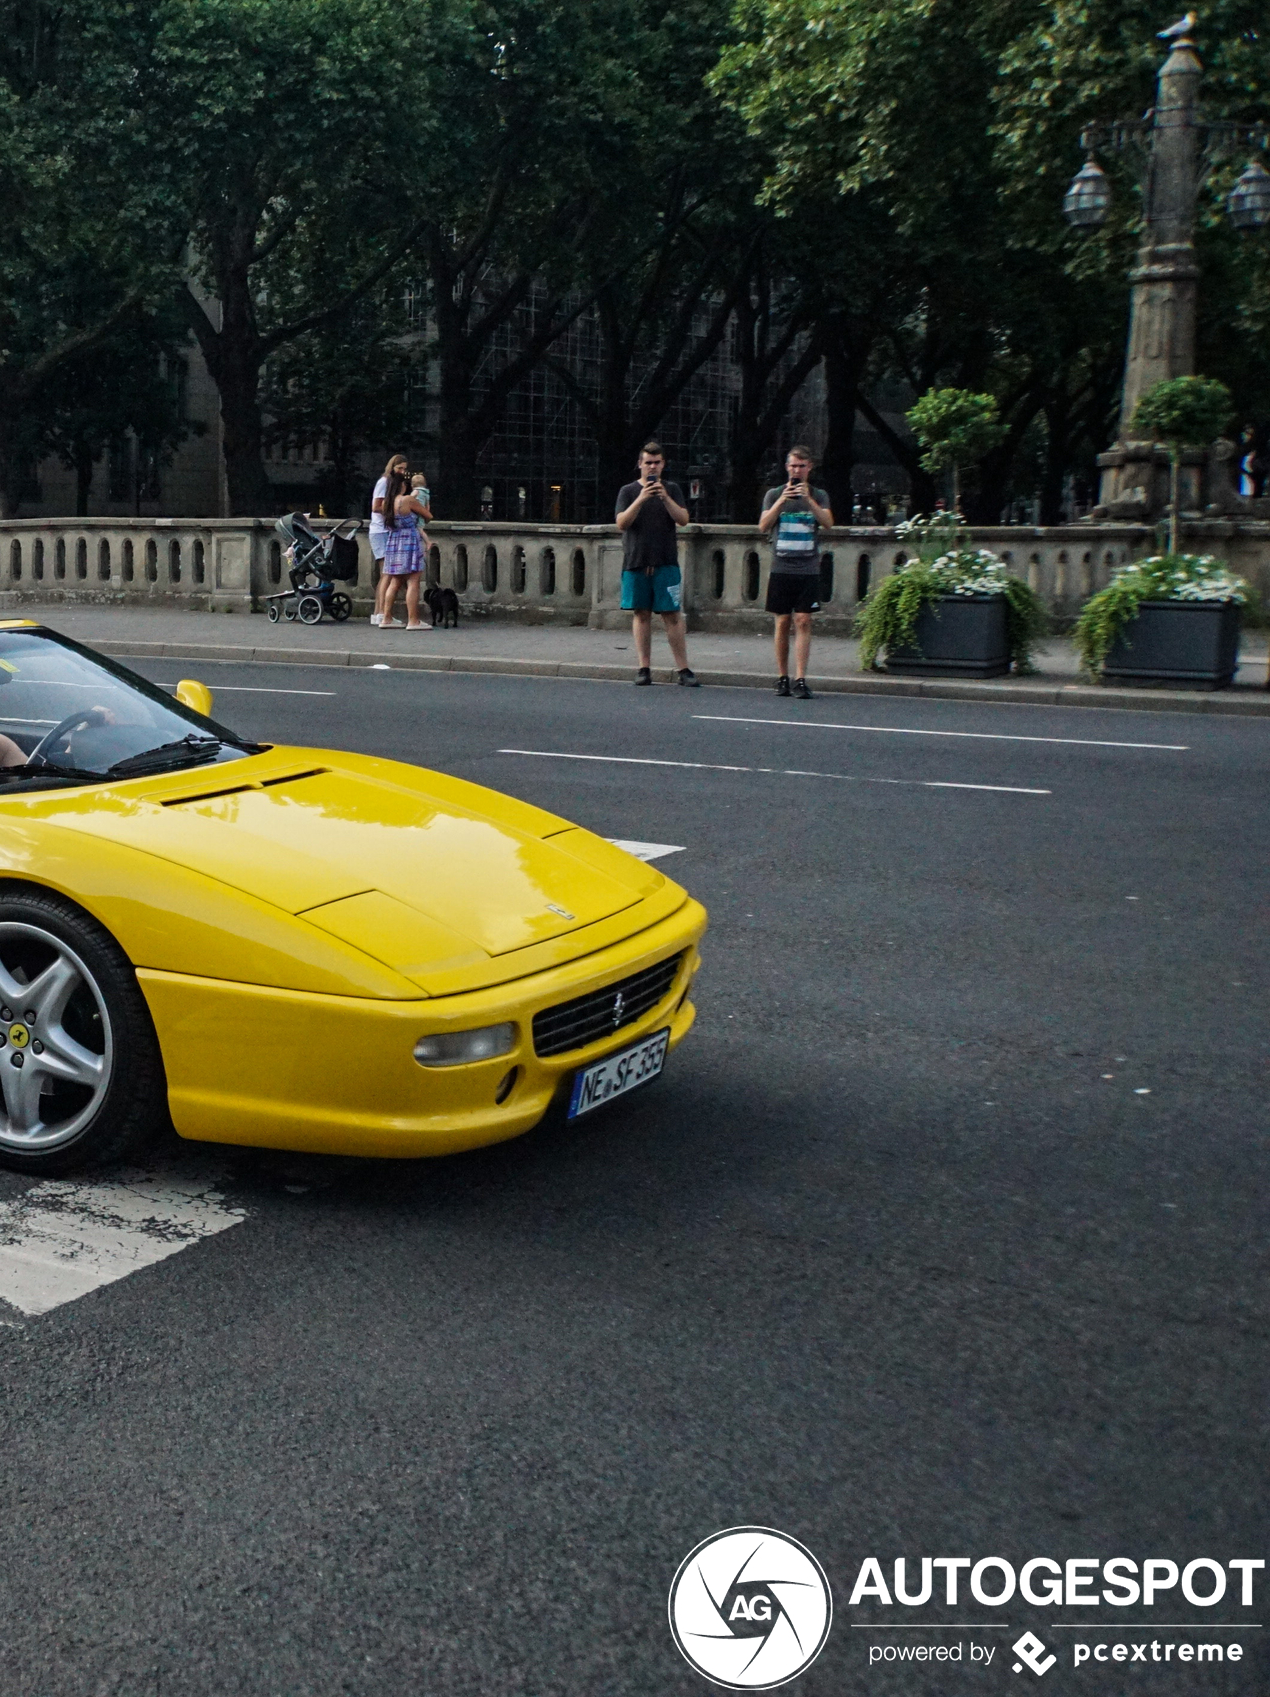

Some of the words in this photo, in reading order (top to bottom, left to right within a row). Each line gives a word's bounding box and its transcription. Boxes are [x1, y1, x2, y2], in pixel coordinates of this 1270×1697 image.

[579, 1066, 607, 1109] NE
[613, 1051, 639, 1092] SF
[635, 1036, 666, 1080] 355
